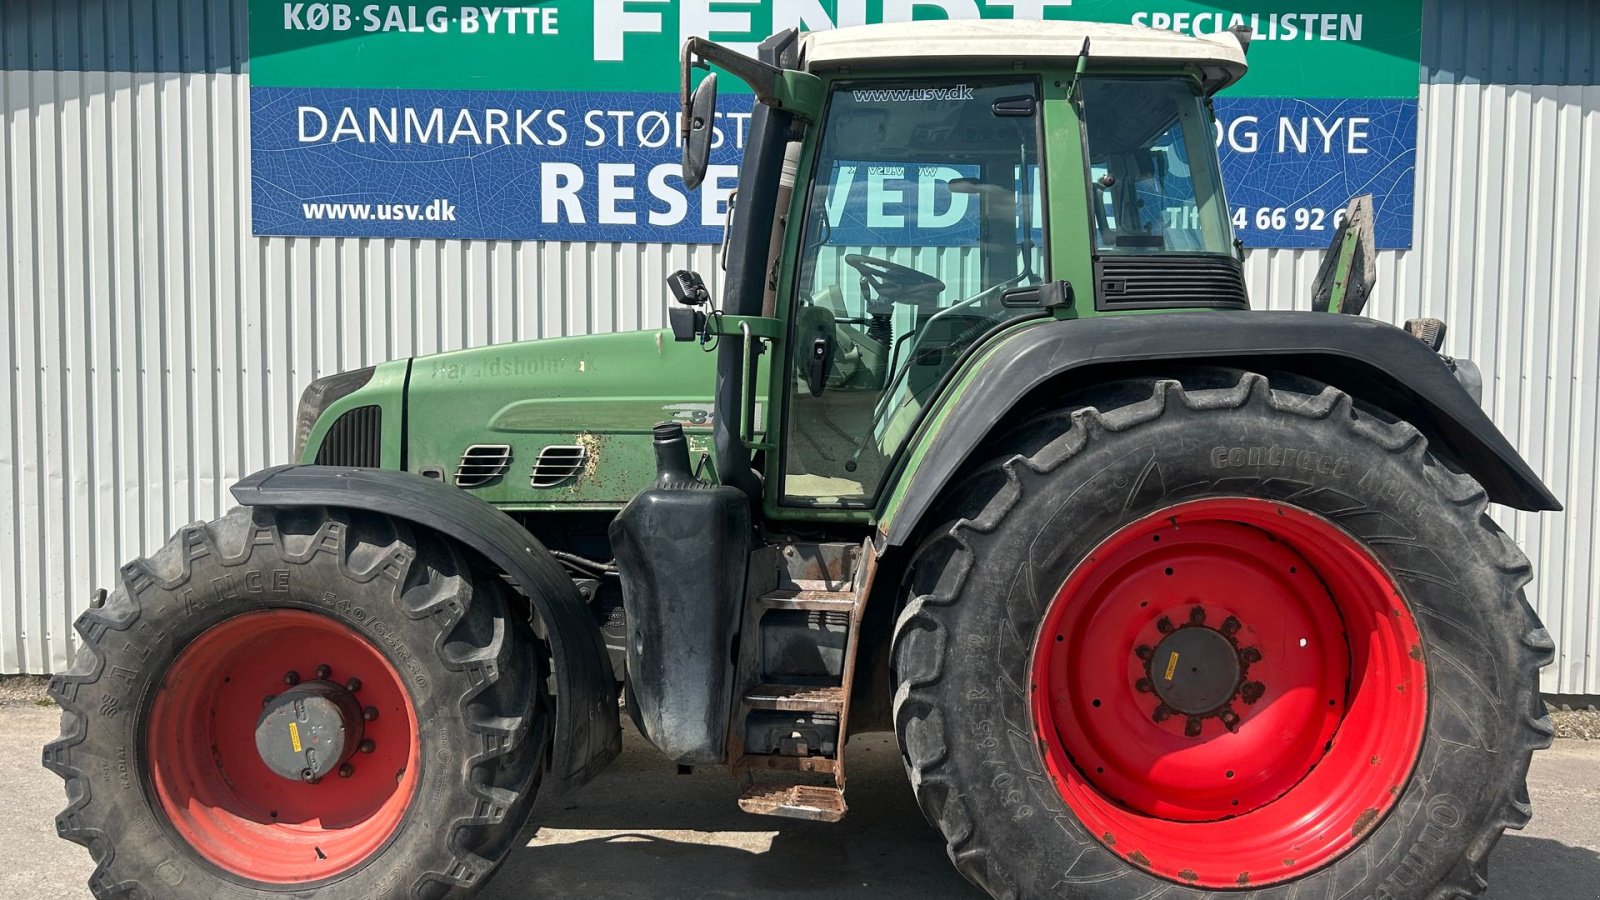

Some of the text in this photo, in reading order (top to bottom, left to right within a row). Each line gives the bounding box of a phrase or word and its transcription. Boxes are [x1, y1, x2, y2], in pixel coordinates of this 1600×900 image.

[853, 84, 974, 102] www.usv.dk
[297, 106, 568, 147] DANMARKS
[1278, 116, 1370, 154] NYE
[302, 199, 456, 222] www.usv.dk
[1256, 207, 1287, 230] 66
[1295, 208, 1325, 231] 92
